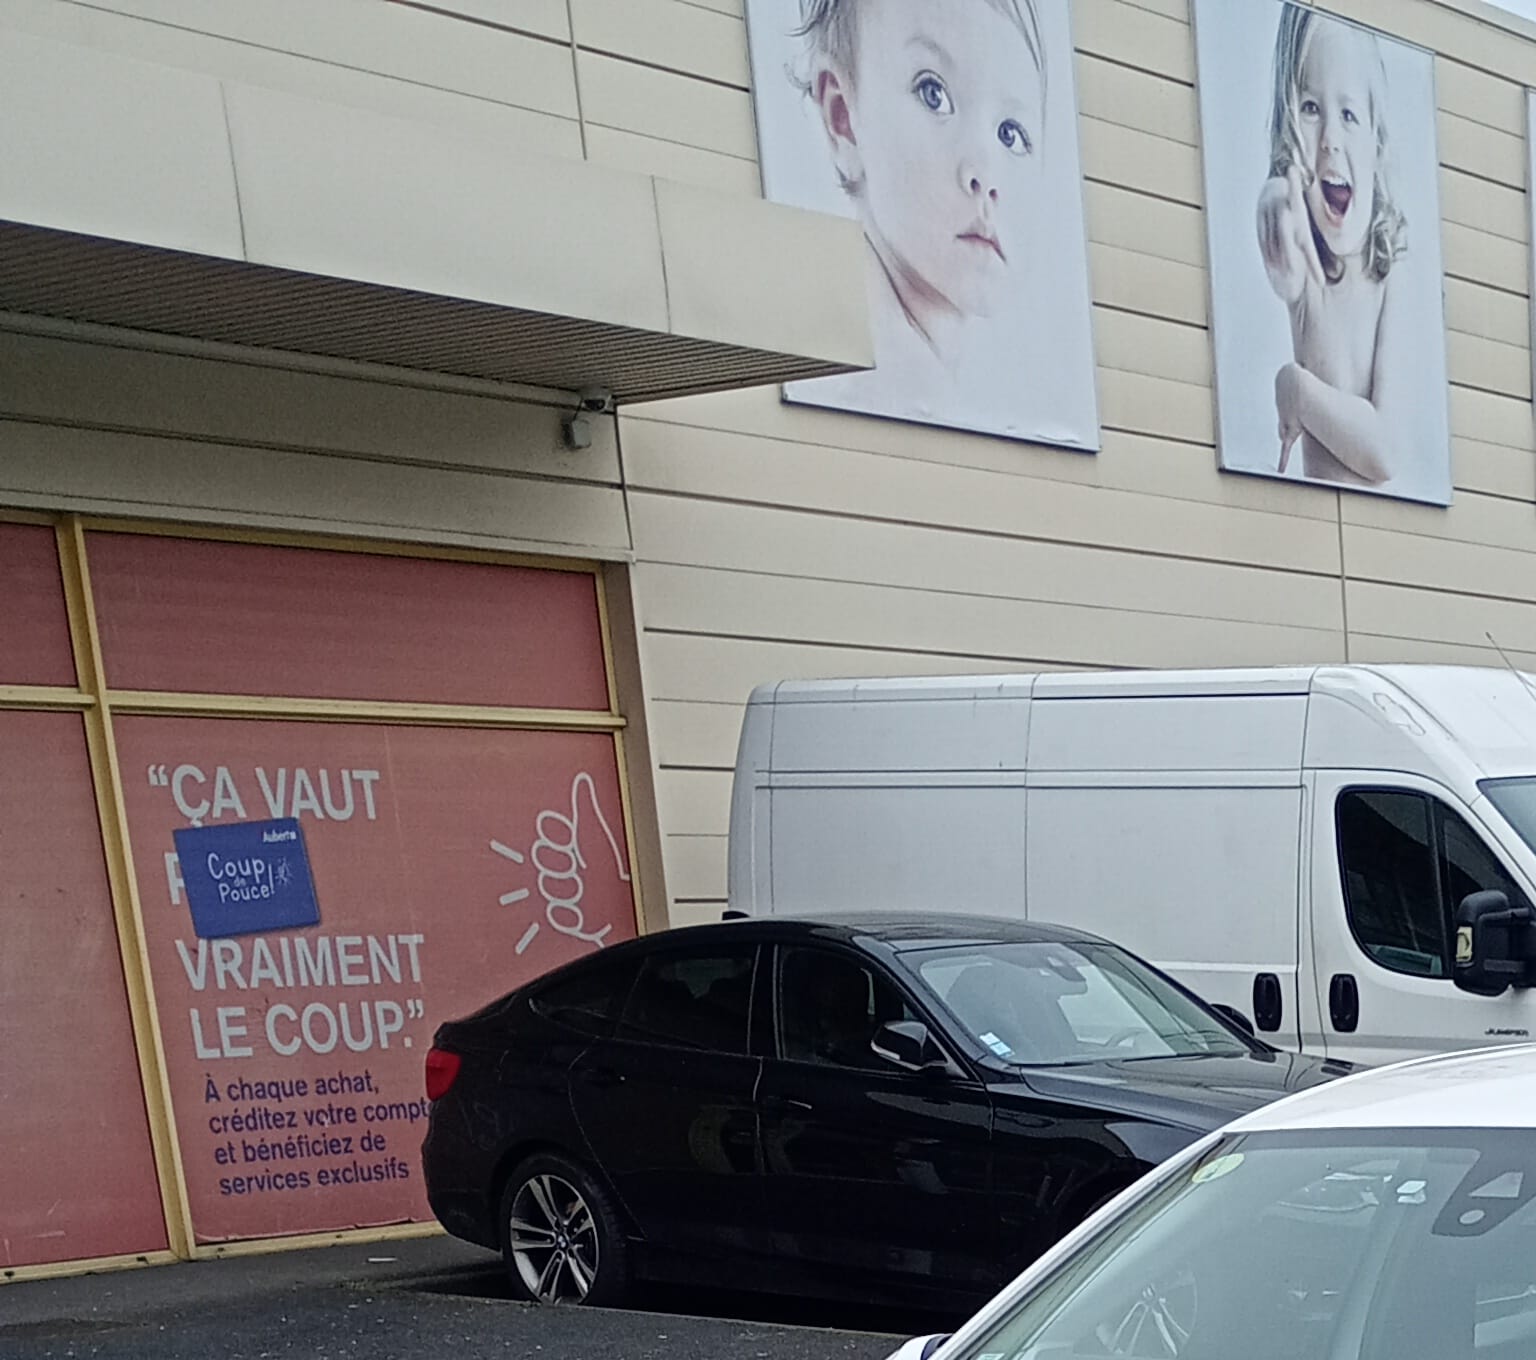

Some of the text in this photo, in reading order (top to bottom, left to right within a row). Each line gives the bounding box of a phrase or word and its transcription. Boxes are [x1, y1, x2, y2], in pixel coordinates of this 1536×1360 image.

[255, 766, 380, 821] VAUT
[207, 852, 266, 884] Coup
[174, 934, 425, 991] VRAIMENT
[190, 1006, 254, 1060] LE
[204, 1069, 380, 1104] À chaque achat,
[208, 1097, 430, 1134] créditez votre compt
[214, 1130, 387, 1165] et bénéficiez de
[219, 1156, 410, 1196] services exclusifs
